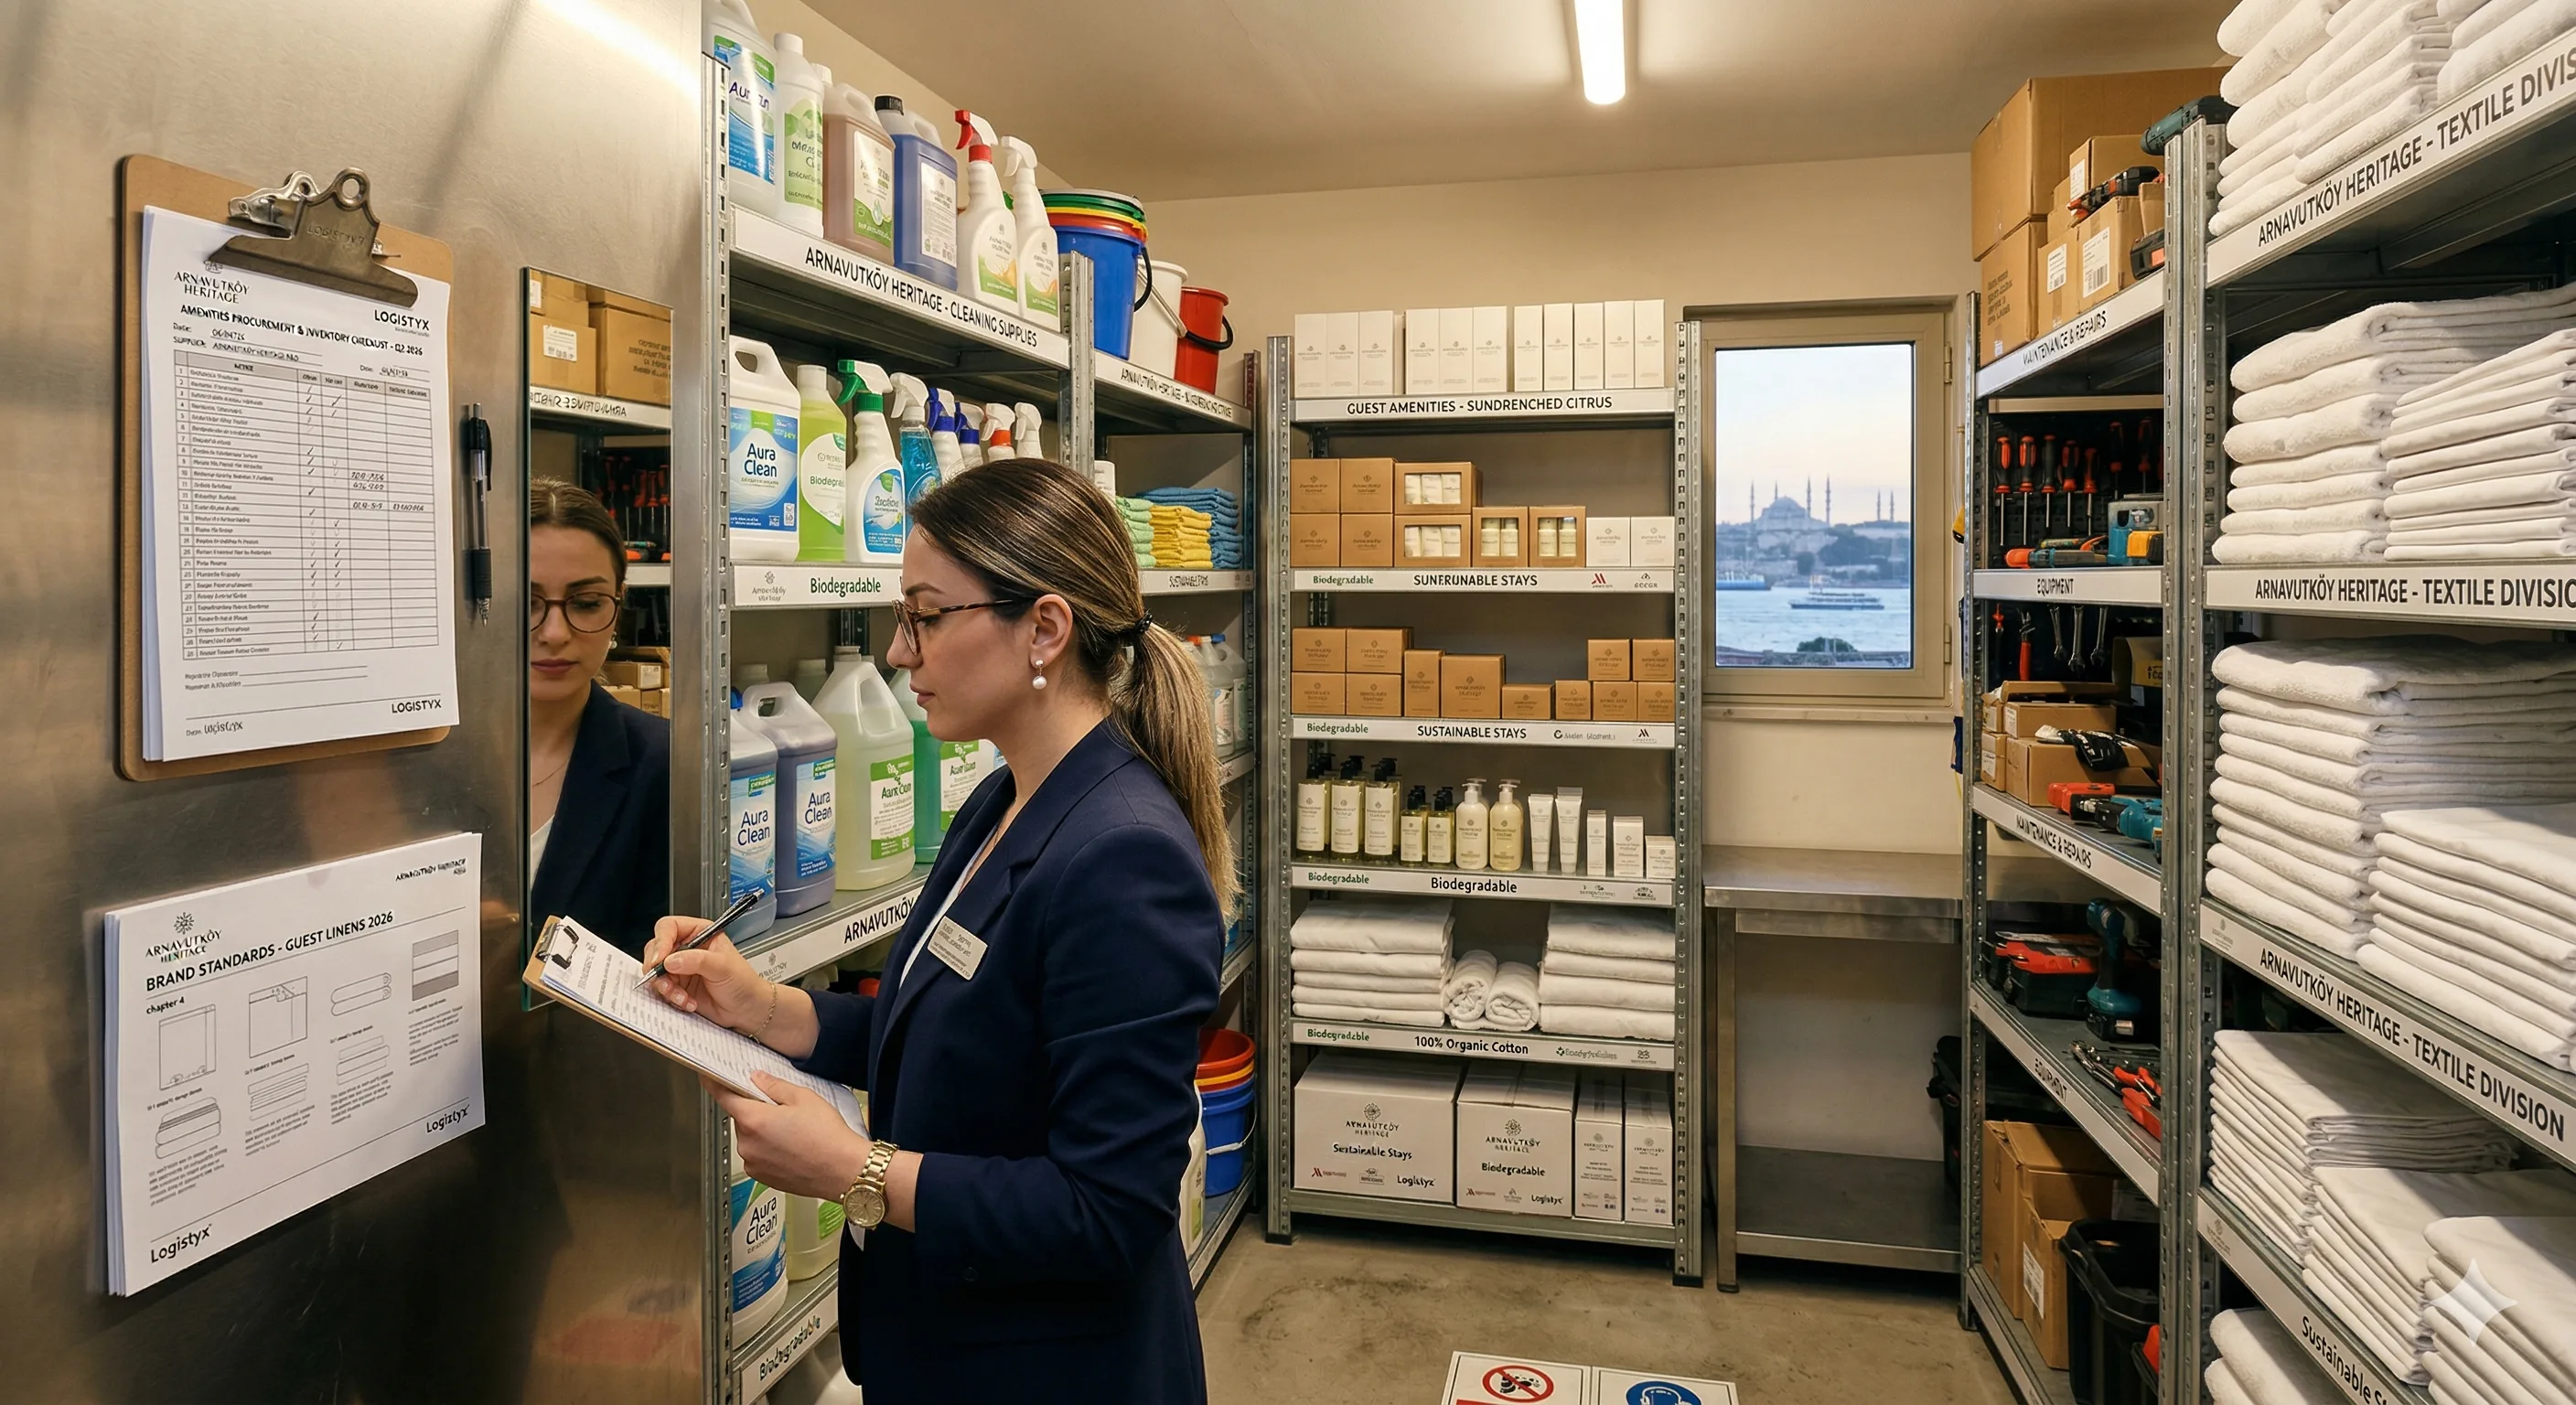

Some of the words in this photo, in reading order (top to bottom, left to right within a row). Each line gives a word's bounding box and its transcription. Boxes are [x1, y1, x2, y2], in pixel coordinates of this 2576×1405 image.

[2258, 179, 2342, 247] ARNAVUTKÖY
[2345, 135, 2422, 201] HERITAGE
[2437, 83, 2514, 150] TEXTILE
[891, 279, 942, 313] HERITAGE
[950, 302, 997, 332] CLEANING
[374, 309, 430, 331] LOGISTYX
[1347, 402, 1387, 414] GUEST
[1389, 401, 1456, 414] AMENITIES
[1466, 397, 1565, 413] SUNDRENCHED
[1566, 396, 1613, 410] CITRUS
[747, 443, 776, 461] Aura
[744, 459, 778, 477] Clean
[810, 577, 881, 597] Biodegradable
[1500, 574, 1538, 586] STAYS
[2338, 578, 2408, 604] HERITAGE
[2422, 578, 2495, 606] TEXTILE
[392, 699, 442, 713] LOGISTYX
[1417, 725, 1491, 738] SUSTAINABLE
[1493, 727, 1527, 738] STAYS
[808, 792, 832, 808] Aura
[741, 810, 768, 829] Aura
[737, 826, 770, 846] Clean
[1308, 872, 1369, 885] Biodegradable
[1431, 877, 1517, 894] Biodegradable
[146, 966, 196, 992] BRAND
[199, 944, 275, 977] STANDARDS
[285, 930, 323, 951] GUEST
[326, 918, 366, 940] LINENS
[368, 911, 393, 928] 2026
[146, 1000, 178, 1014] chapter
[1414, 1035, 1443, 1048] 100%
[1446, 1038, 1489, 1053] Organic
[1491, 1040, 1529, 1054] Cotton
[2337, 989, 2401, 1046] HERITAGE
[2413, 1033, 2475, 1090] TEXTILE
[2480, 1071, 2565, 1142] DIVISION
[1389, 1148, 1412, 1161] Stays
[750, 1196, 777, 1226] Aura
[746, 1213, 778, 1245] Clean
[2302, 1315, 2371, 1405] Sustainable
